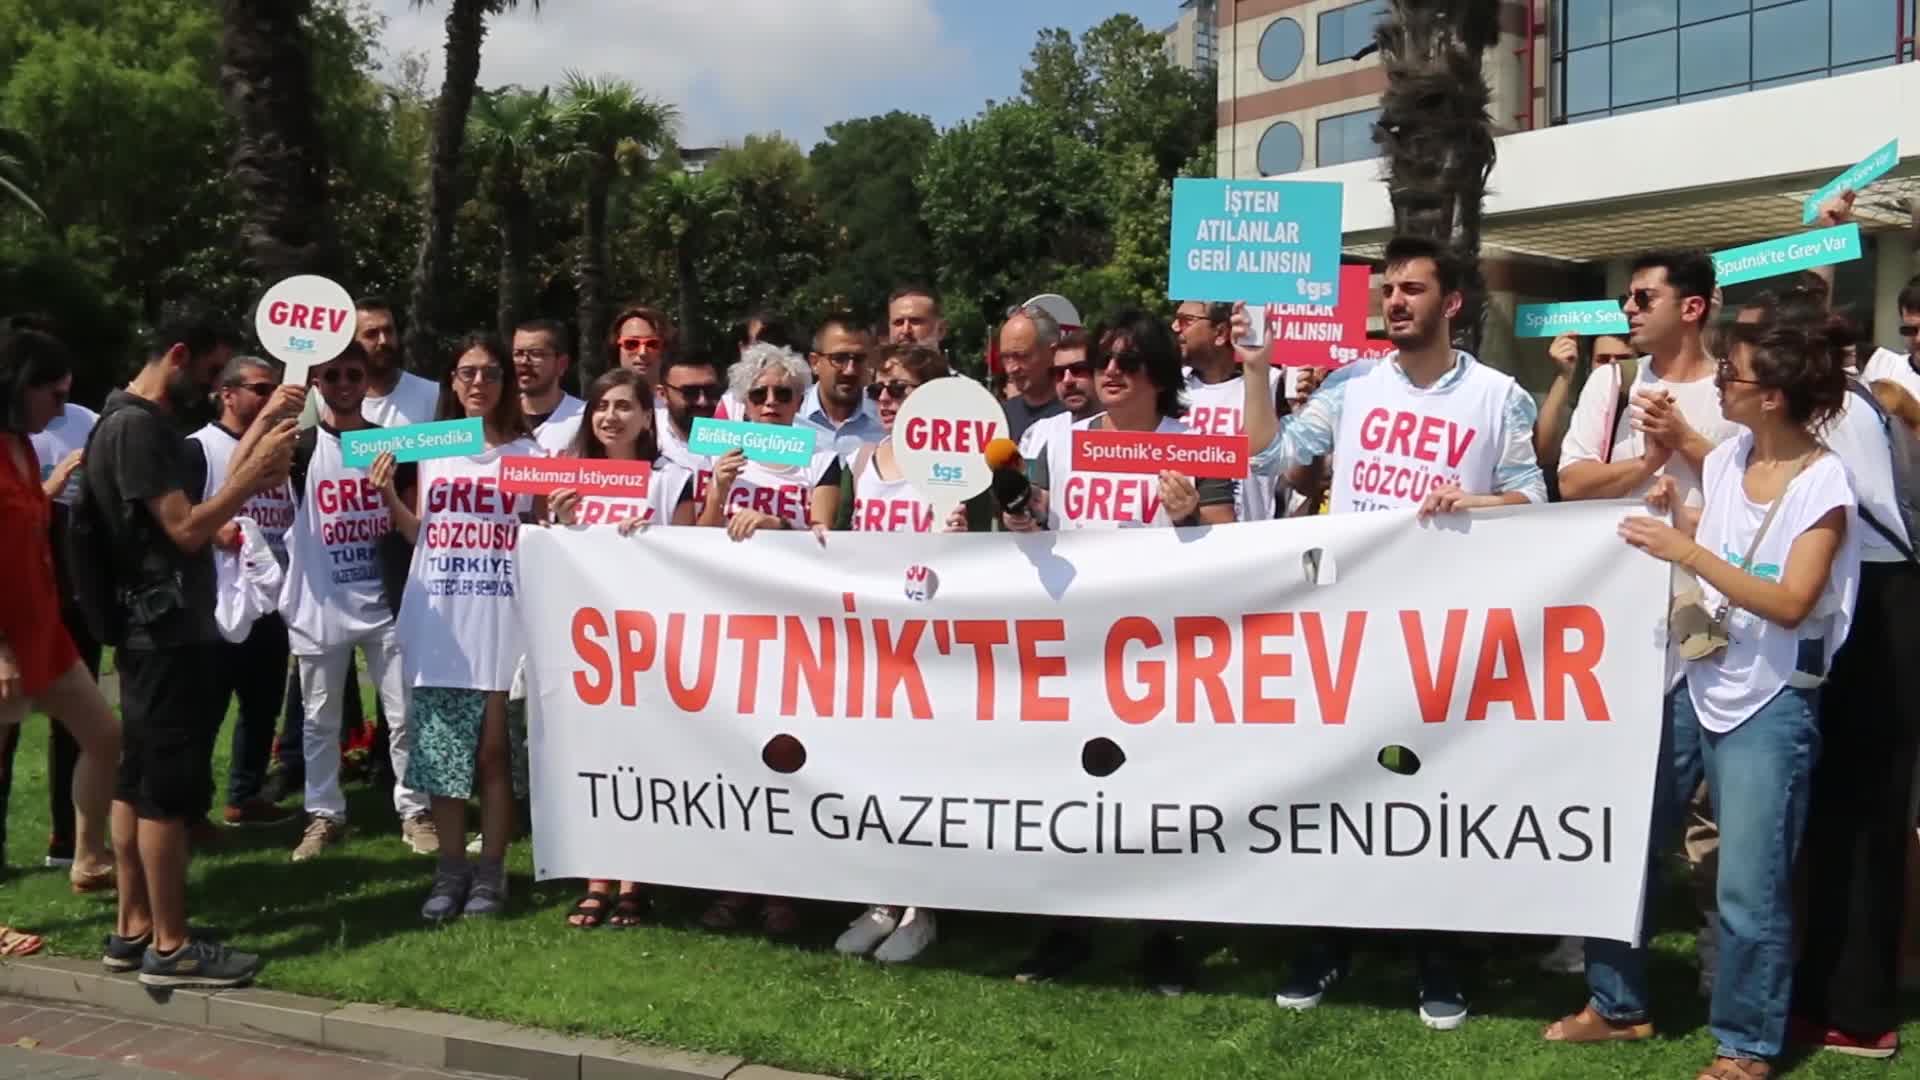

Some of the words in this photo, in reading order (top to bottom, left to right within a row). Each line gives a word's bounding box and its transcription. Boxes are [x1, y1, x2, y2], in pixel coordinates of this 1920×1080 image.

[1225, 185, 1280, 217] İŞTEN
[1196, 220, 1299, 243] ATILANLAR
[1187, 245, 1231, 271] GERİ
[1236, 251, 1312, 274] ALINSIN
[1715, 249, 1784, 276] Sputnik'te
[1787, 242, 1821, 260] Grev
[1823, 235, 1847, 251] Var
[1296, 278, 1333, 301] tgs
[269, 301, 348, 333] GREV
[1284, 321, 1343, 342] ALINSIN
[1329, 344, 1359, 363] tgs
[351, 435, 415, 456] Sputnik'e
[417, 431, 473, 448] Sendika
[697, 427, 740, 447] Birlikte
[742, 431, 805, 455] Güçlüyüz
[905, 417, 997, 453] GREV
[1360, 407, 1476, 469] GREV
[1082, 441, 1163, 461] Sputnik'e
[1166, 445, 1237, 464] Sendika
[503, 466, 576, 483] Hakkımızı
[578, 467, 644, 488] İstiyoruz
[932, 463, 962, 480] tgs
[317, 477, 383, 514] GRE
[428, 477, 517, 515] GREV
[1064, 476, 1162, 524] GREV
[426, 516, 518, 551] GÖZCÜSÜ
[429, 554, 513, 576] TÜRKİYE
[571, 592, 1069, 721] SPUTNİK'TE
[1104, 610, 1367, 724] GREV
[1400, 605, 1611, 723] VAR
[577, 766, 796, 835] TÜRKİYE
[811, 791, 1227, 856] GAZETECİLER
[1248, 792, 1611, 864] SENDİKASI
